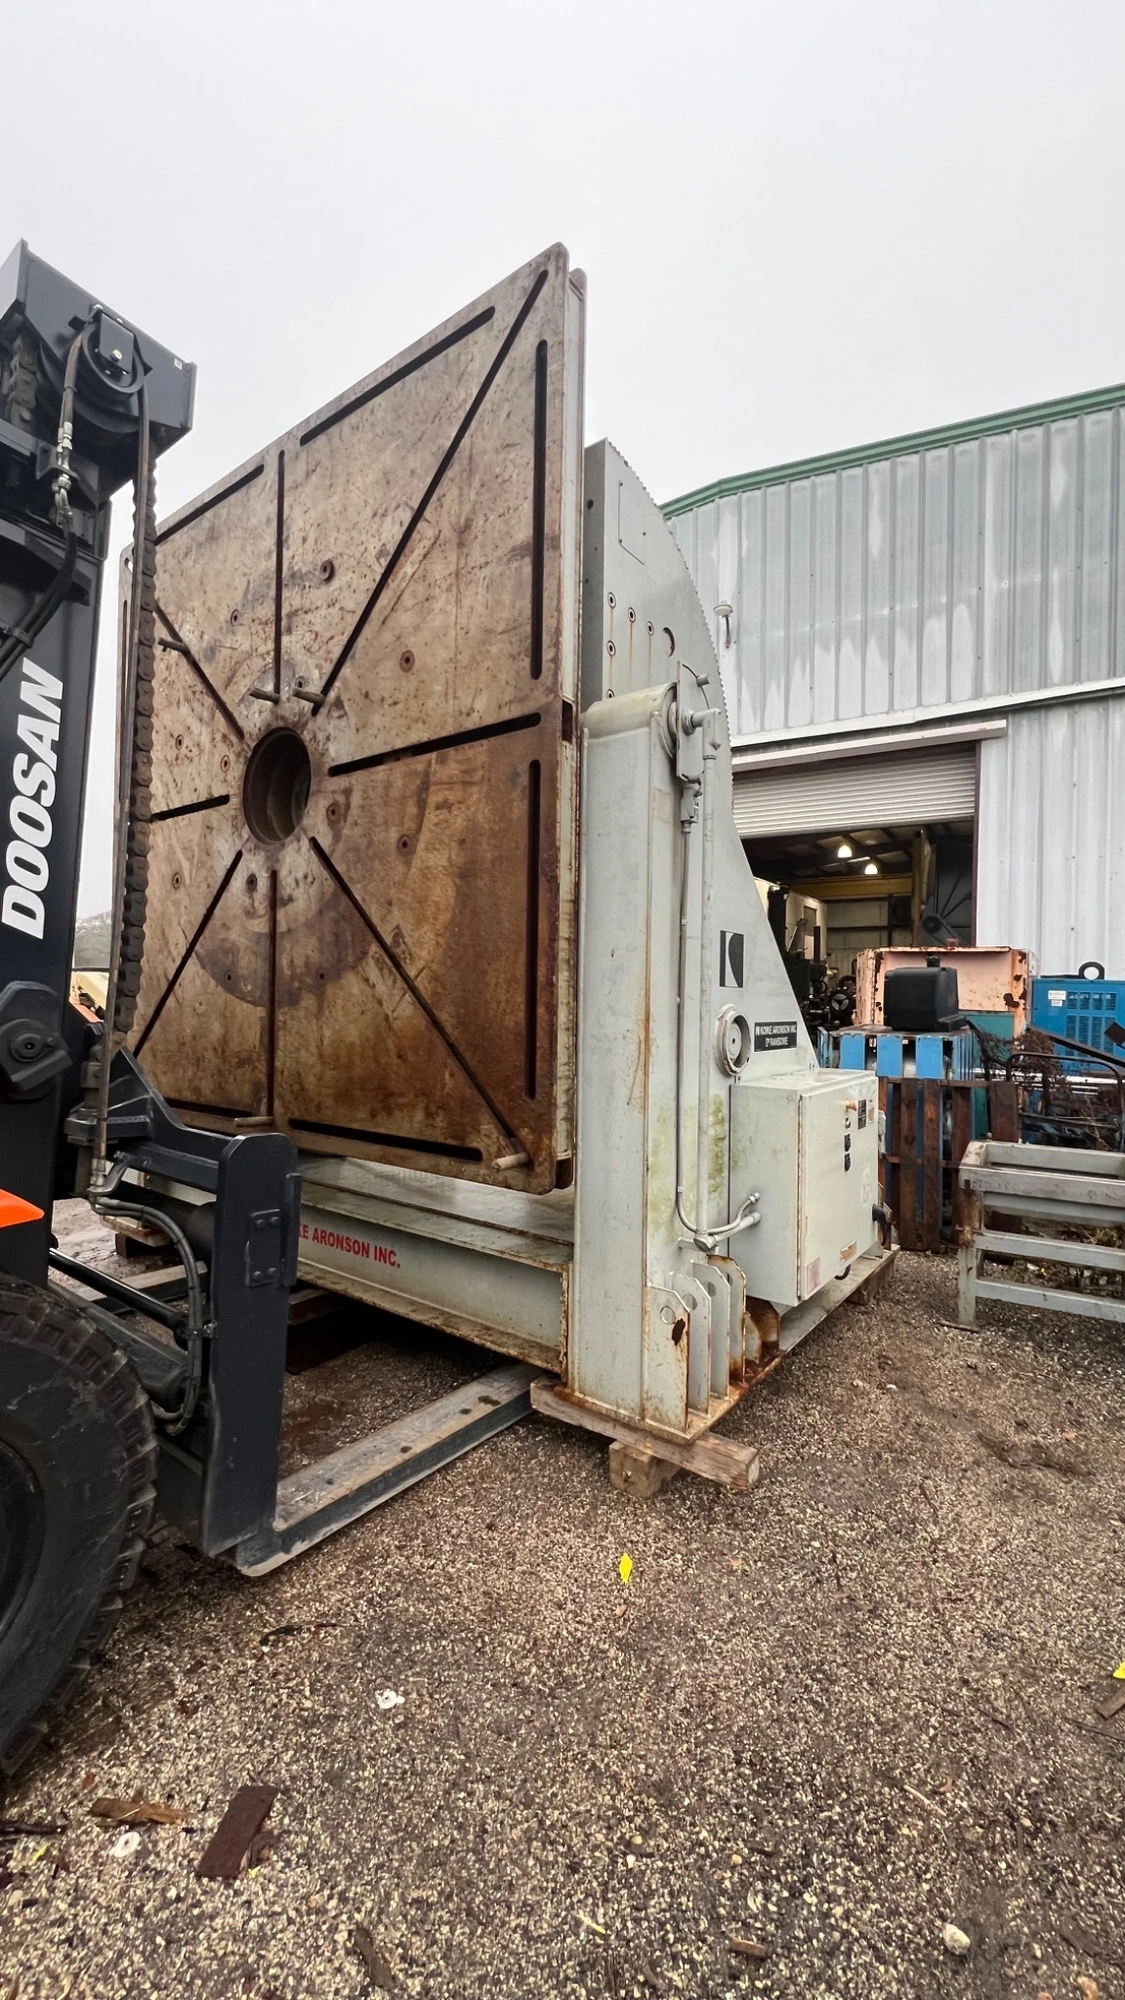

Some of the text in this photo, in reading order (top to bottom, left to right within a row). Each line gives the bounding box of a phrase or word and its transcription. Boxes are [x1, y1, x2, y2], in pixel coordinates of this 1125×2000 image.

[2, 657, 63, 939] DOOSAN
[312, 1227, 370, 1259] ARONSON
[374, 1245, 401, 1269] INC.
